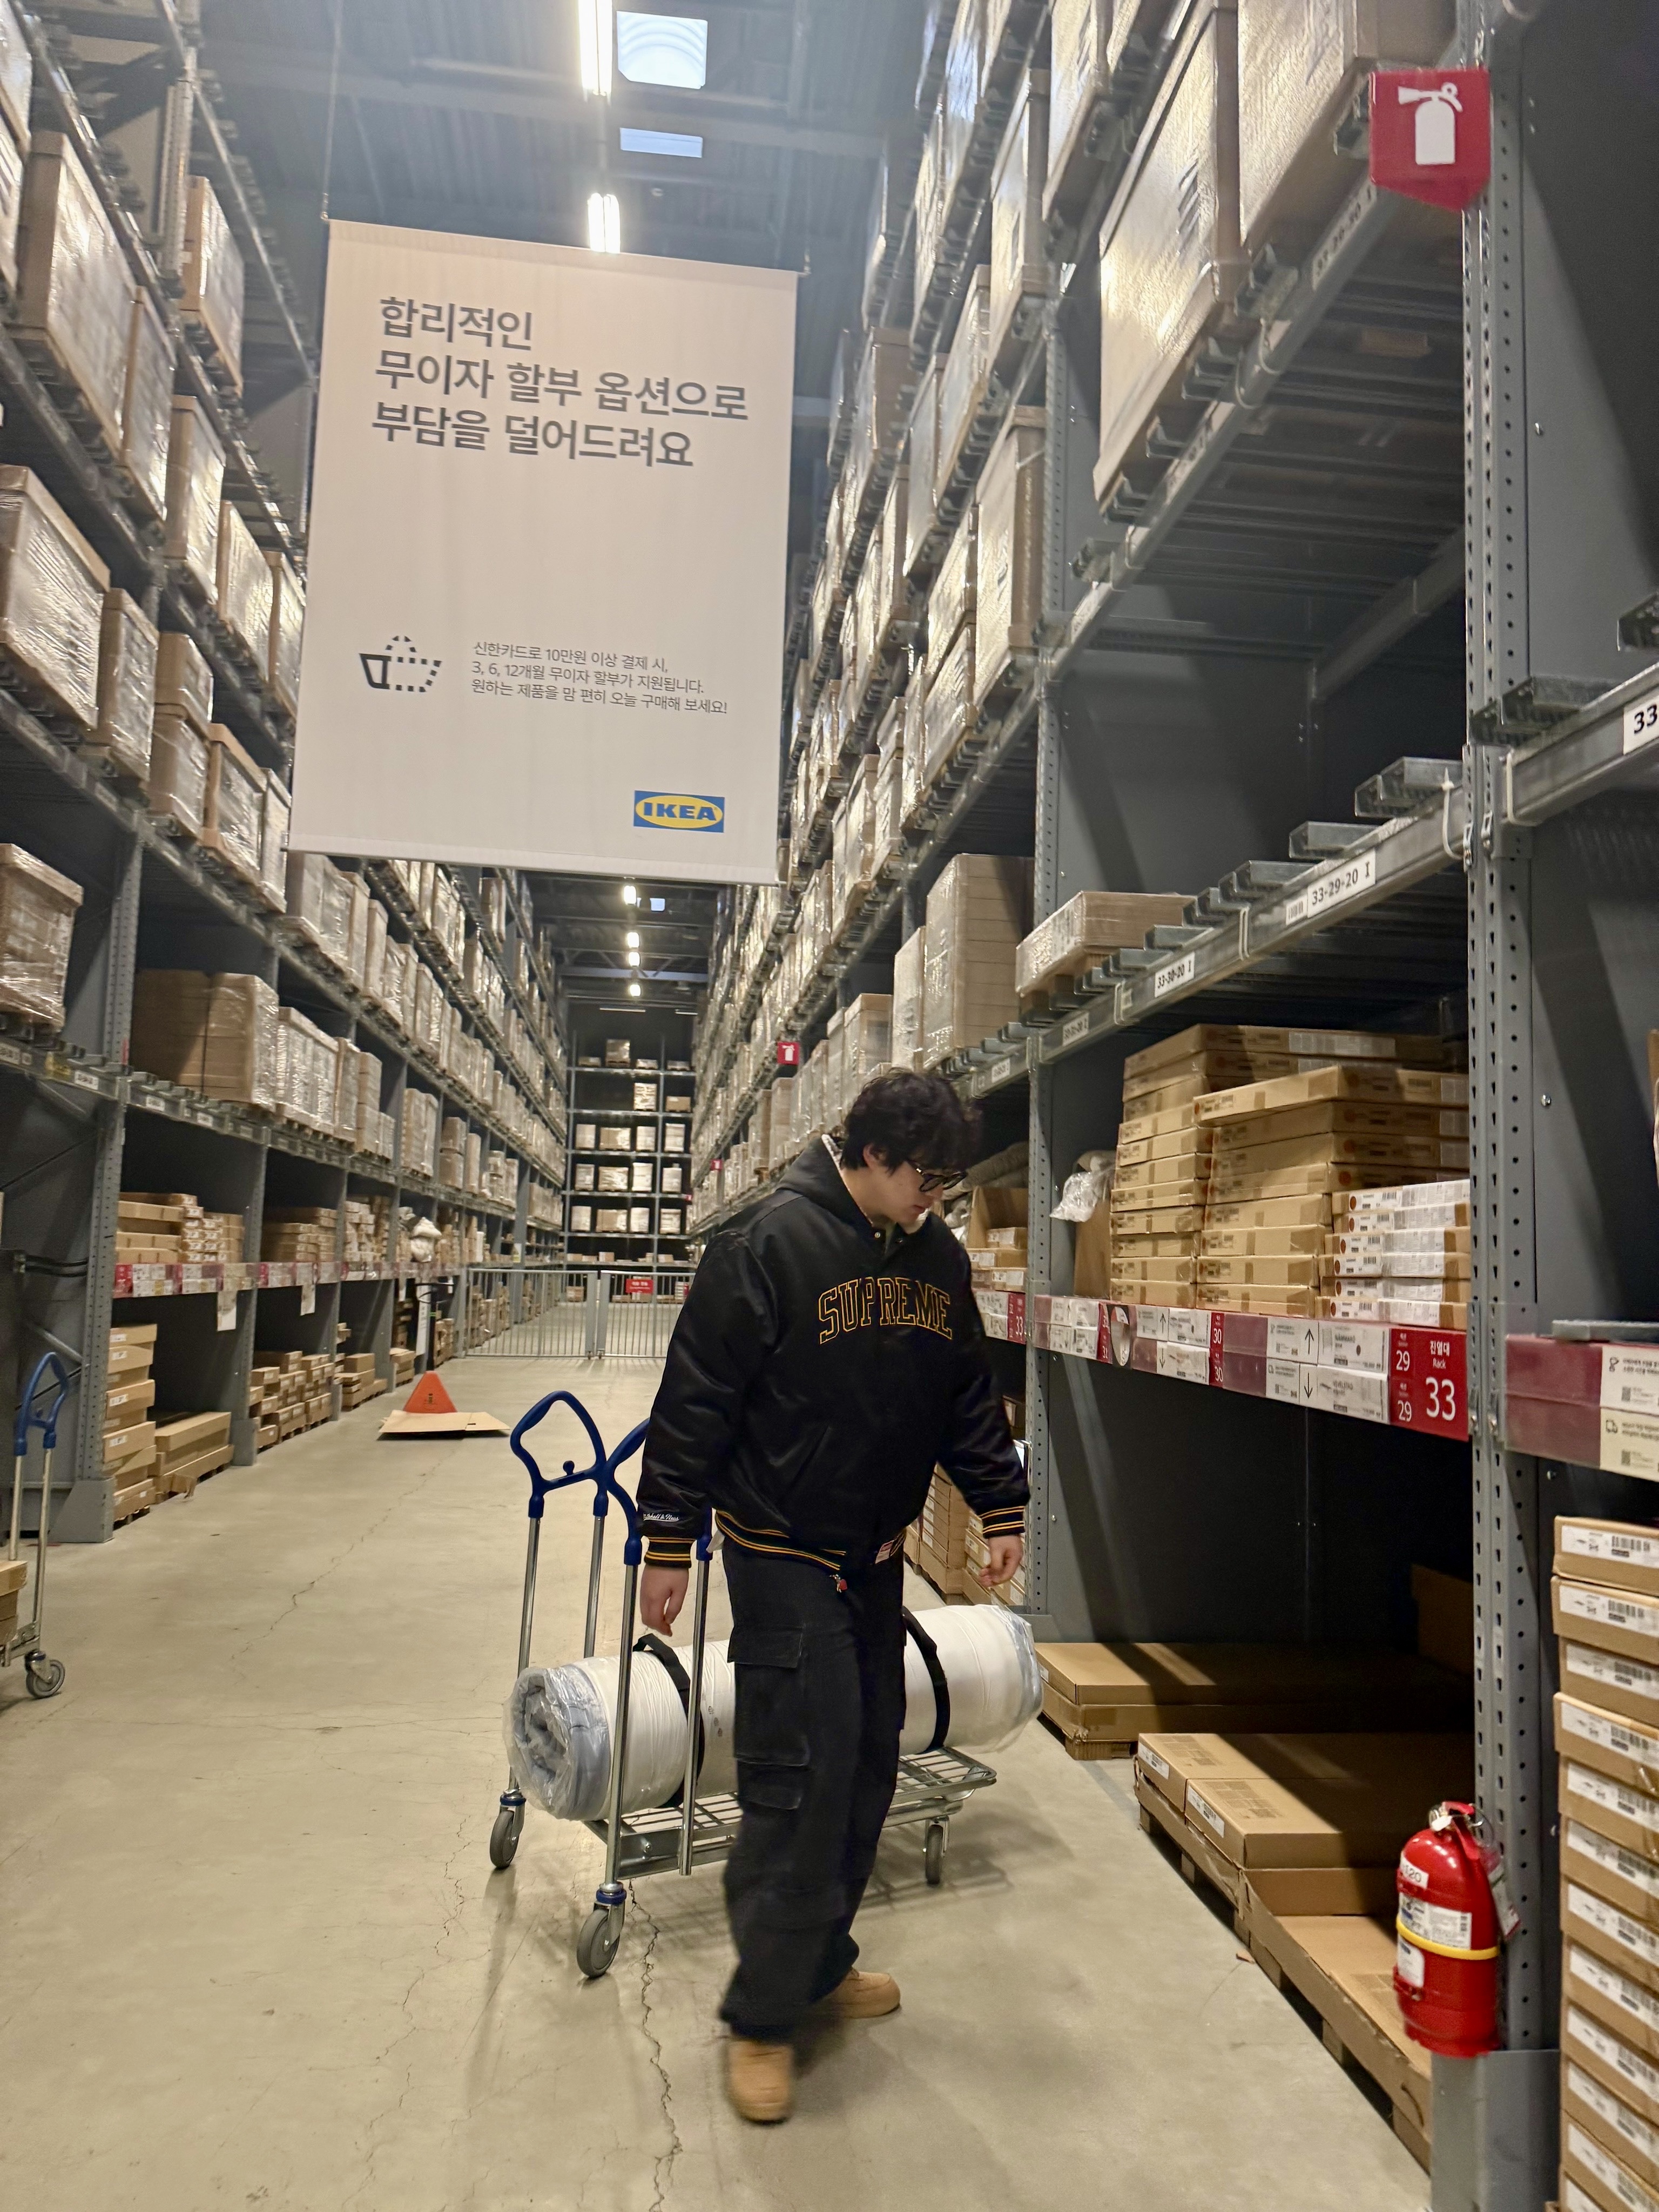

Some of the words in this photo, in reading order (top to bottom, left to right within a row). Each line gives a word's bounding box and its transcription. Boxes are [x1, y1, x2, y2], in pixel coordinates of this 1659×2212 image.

[380, 296, 534, 351] 합리적인
[375, 349, 494, 399] 무이자
[507, 362, 583, 407] 할부
[595, 372, 749, 421] 옵션으로
[372, 401, 490, 451] 부담을
[504, 415, 693, 468] 덜어드려요
[474, 642, 543, 660] 신한카드로
[545, 649, 587, 665] 10만원
[591, 651, 618, 668] 이상
[622, 655, 648, 670] 결제
[652, 658, 668, 673] 시,
[471, 662, 484, 675] 3,
[488, 663, 501, 677] 6,
[505, 665, 545, 680] 12개월
[550, 667, 590, 684] 무이자
[594, 670, 634, 688] 할부가
[637, 675, 704, 694] 지원됩니다.
[471, 679, 513, 696] 원하는
[517, 684, 559, 700] 제품을
[563, 687, 577, 702] 맘
[581, 689, 606, 704] 편히
[609, 692, 637, 707] 오늘
[641, 693, 680, 711] 구매해
[684, 698, 727, 714] 보세요!
[644, 802, 717, 821] IKEA
[1312, 868, 1359, 906] 33-29-20
[818, 1276, 953, 1345] SUPREME
[1213, 1328, 1222, 1345] 30
[1429, 1340, 1450, 1357] 진열대
[1215, 1366, 1224, 1382] 30
[1395, 1350, 1411, 1372] 29
[1433, 1357, 1446, 1370] Rack
[1397, 1400, 1412, 1422] 29
[1425, 1377, 1456, 1421] 33
